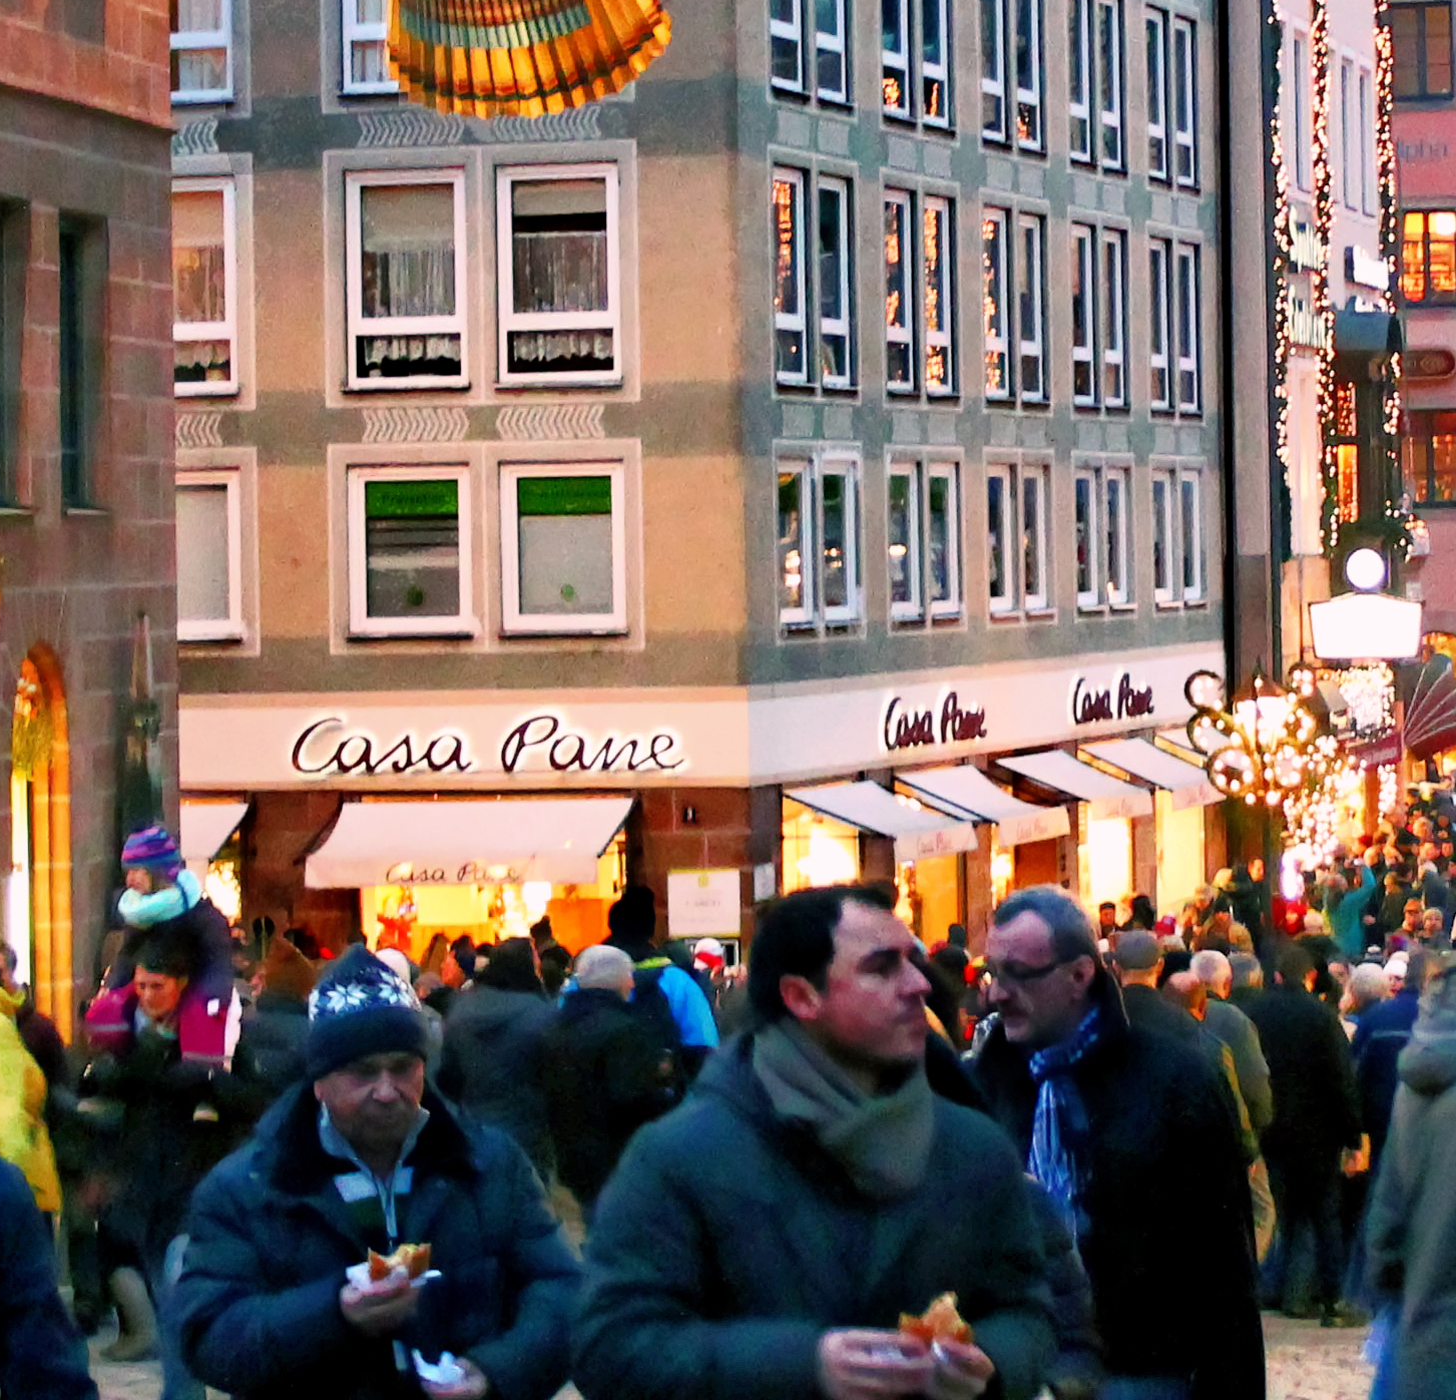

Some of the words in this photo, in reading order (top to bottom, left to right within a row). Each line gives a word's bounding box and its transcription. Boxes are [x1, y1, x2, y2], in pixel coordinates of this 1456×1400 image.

[883, 697, 935, 750] Casa
[940, 691, 988, 743] Pane
[1072, 677, 1113, 725] Casa
[1117, 672, 1155, 720] Pane
[291, 717, 472, 774] Casa
[500, 715, 686, 773] Pane
